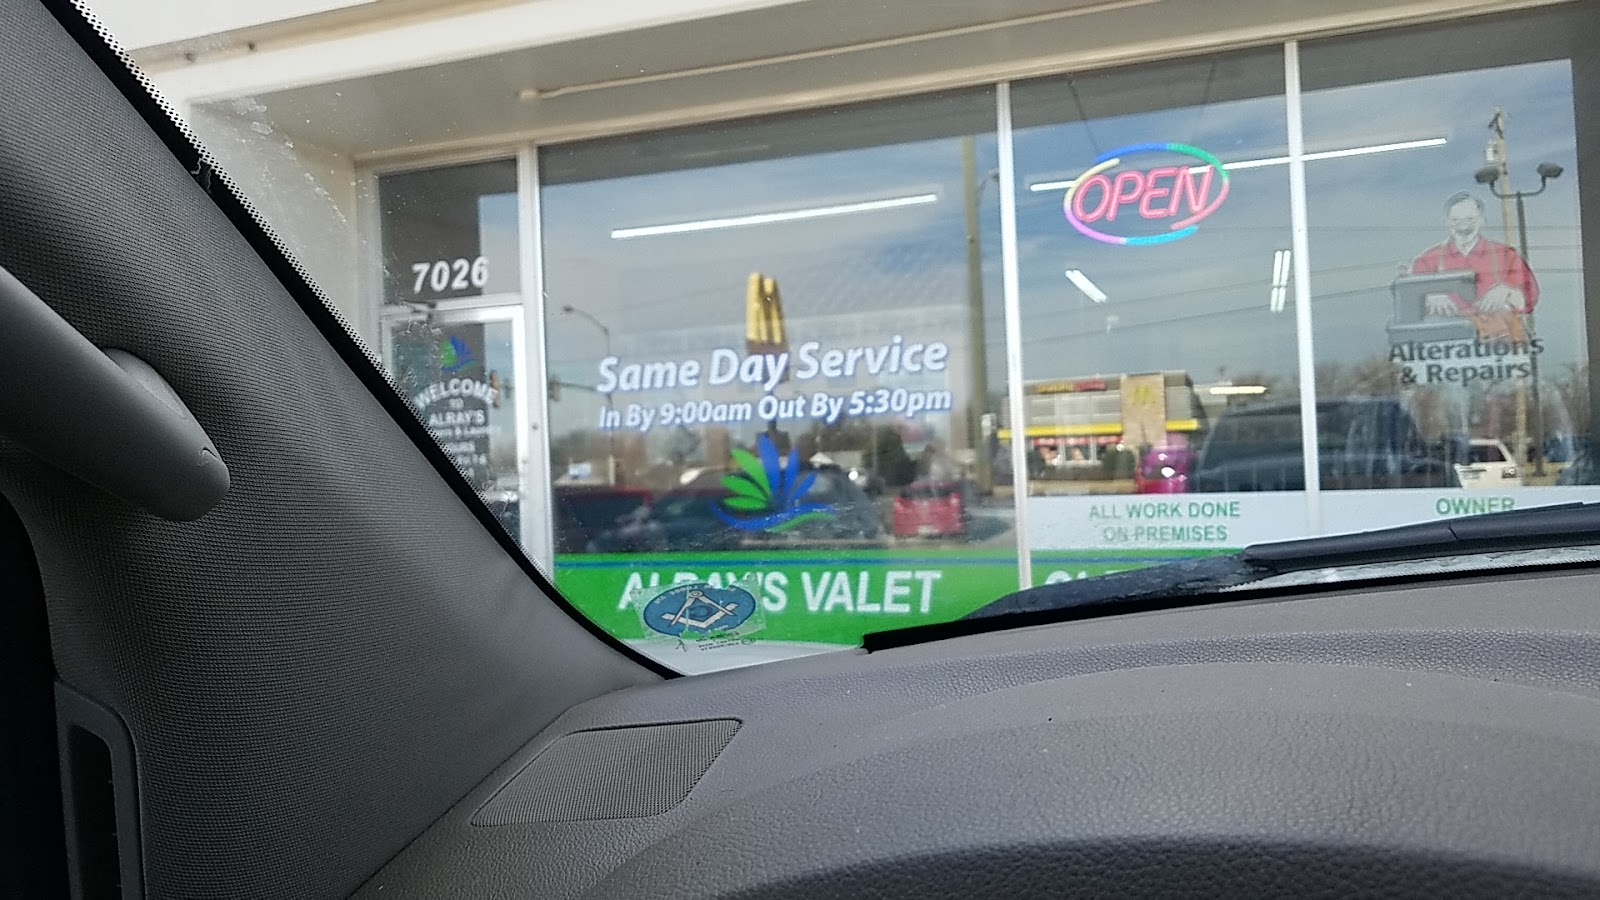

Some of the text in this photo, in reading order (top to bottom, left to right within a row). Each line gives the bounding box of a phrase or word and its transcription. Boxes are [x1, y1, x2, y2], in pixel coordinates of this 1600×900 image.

[1073, 165, 1214, 223] OPEN
[412, 256, 489, 294] 7026
[596, 334, 949, 393] Same Day Service
[1387, 337, 1545, 363] Alterations
[1401, 358, 1531, 388] & Repairs
[413, 377, 498, 410] WELCOME
[599, 388, 951, 433] In By 9:00am Out By 5:30pm
[1089, 501, 1241, 519] ALL WORK DONE
[1435, 496, 1516, 516] OWNER
[1103, 524, 1228, 542] ON PREMISES
[800, 569, 943, 614] VALET
